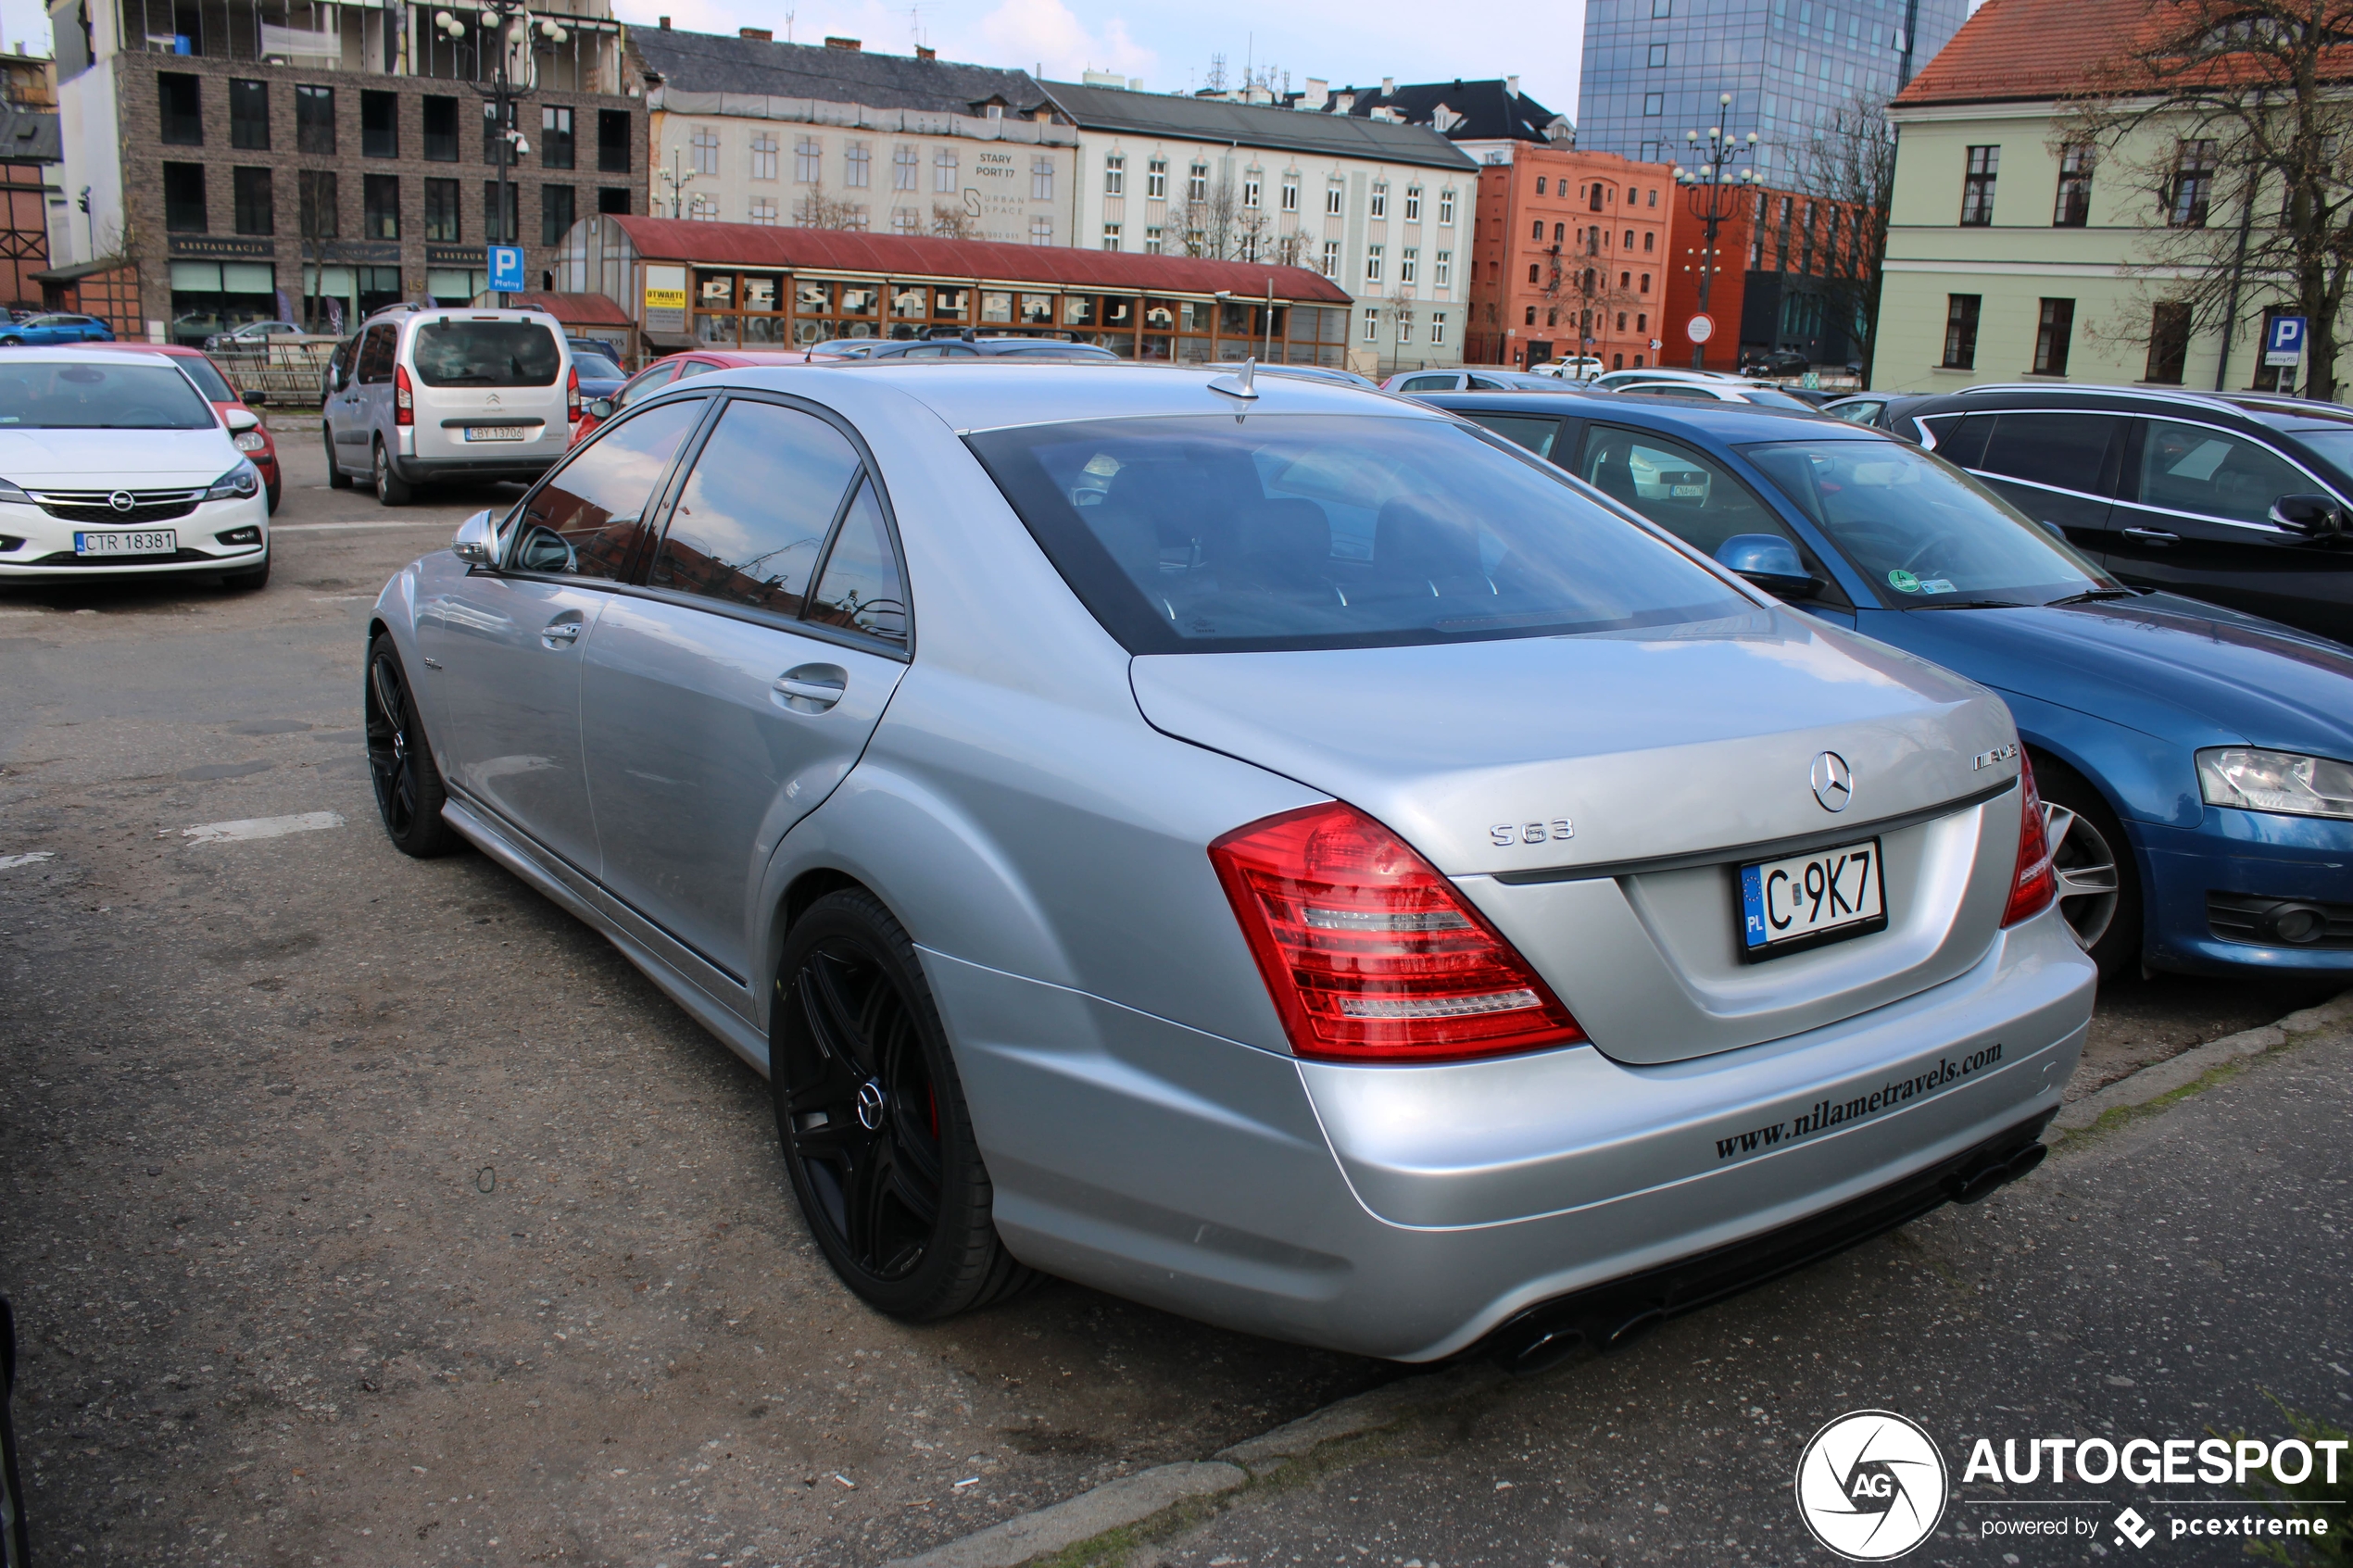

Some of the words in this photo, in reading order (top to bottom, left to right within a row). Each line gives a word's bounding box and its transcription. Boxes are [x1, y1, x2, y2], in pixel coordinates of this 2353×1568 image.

[979, 153, 1012, 164] STARY
[975, 166, 1004, 177] PORT
[1005, 169, 1015, 178] 17
[984, 194, 1025, 204] URBAN
[984, 206, 1024, 215] SPACE
[179, 242, 264, 253] RESTAURACJA
[496, 249, 516, 277] P
[408, 280, 423, 291] 15
[647, 290, 684, 299] OTWARTE
[703, 281, 1173, 322] RESTAURACJA
[2275, 320, 2298, 347] P
[471, 428, 491, 439] CBY
[493, 428, 522, 438] 13706
[85, 534, 118, 550] CTR
[124, 533, 171, 549] 18381
[1490, 817, 1575, 847] S63
[1766, 869, 1793, 930] C
[1804, 850, 1869, 923] 9K7
[1747, 915, 1763, 933] PL
[1715, 1042, 2003, 1159] www.nilametravels.com
